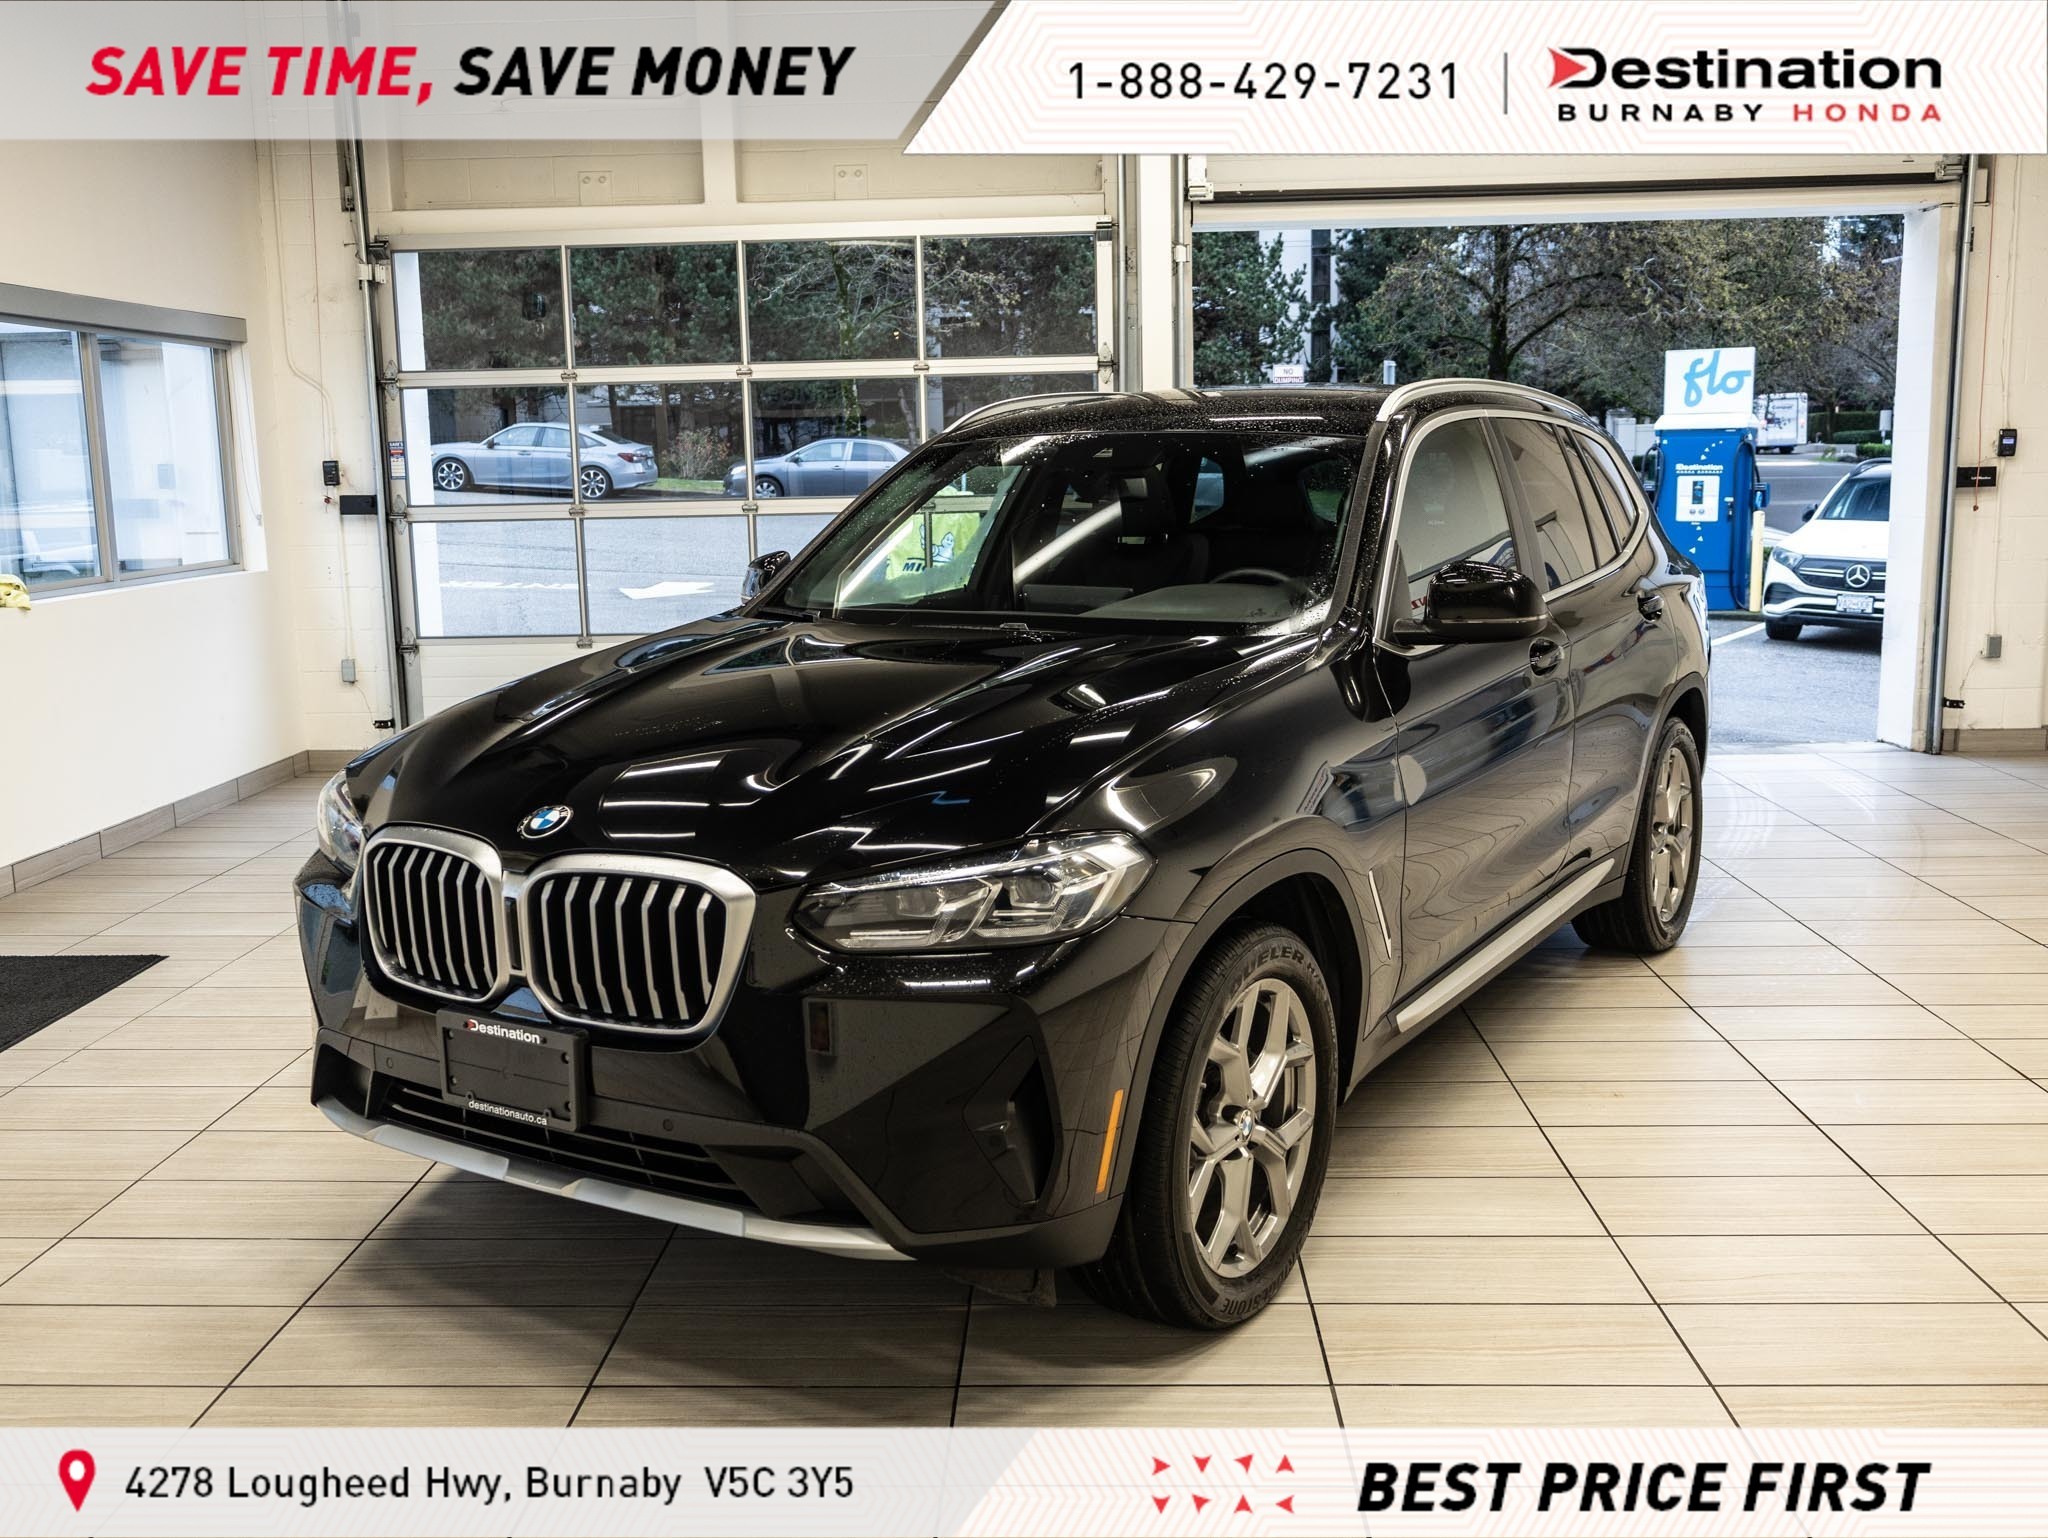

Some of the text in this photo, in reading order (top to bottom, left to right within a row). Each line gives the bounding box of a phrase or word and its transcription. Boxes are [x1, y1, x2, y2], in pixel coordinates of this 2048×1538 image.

[1683, 350, 1751, 407] flo
[468, 1019, 540, 1044] Destination
[468, 1100, 548, 1126] destinationauto.ca
